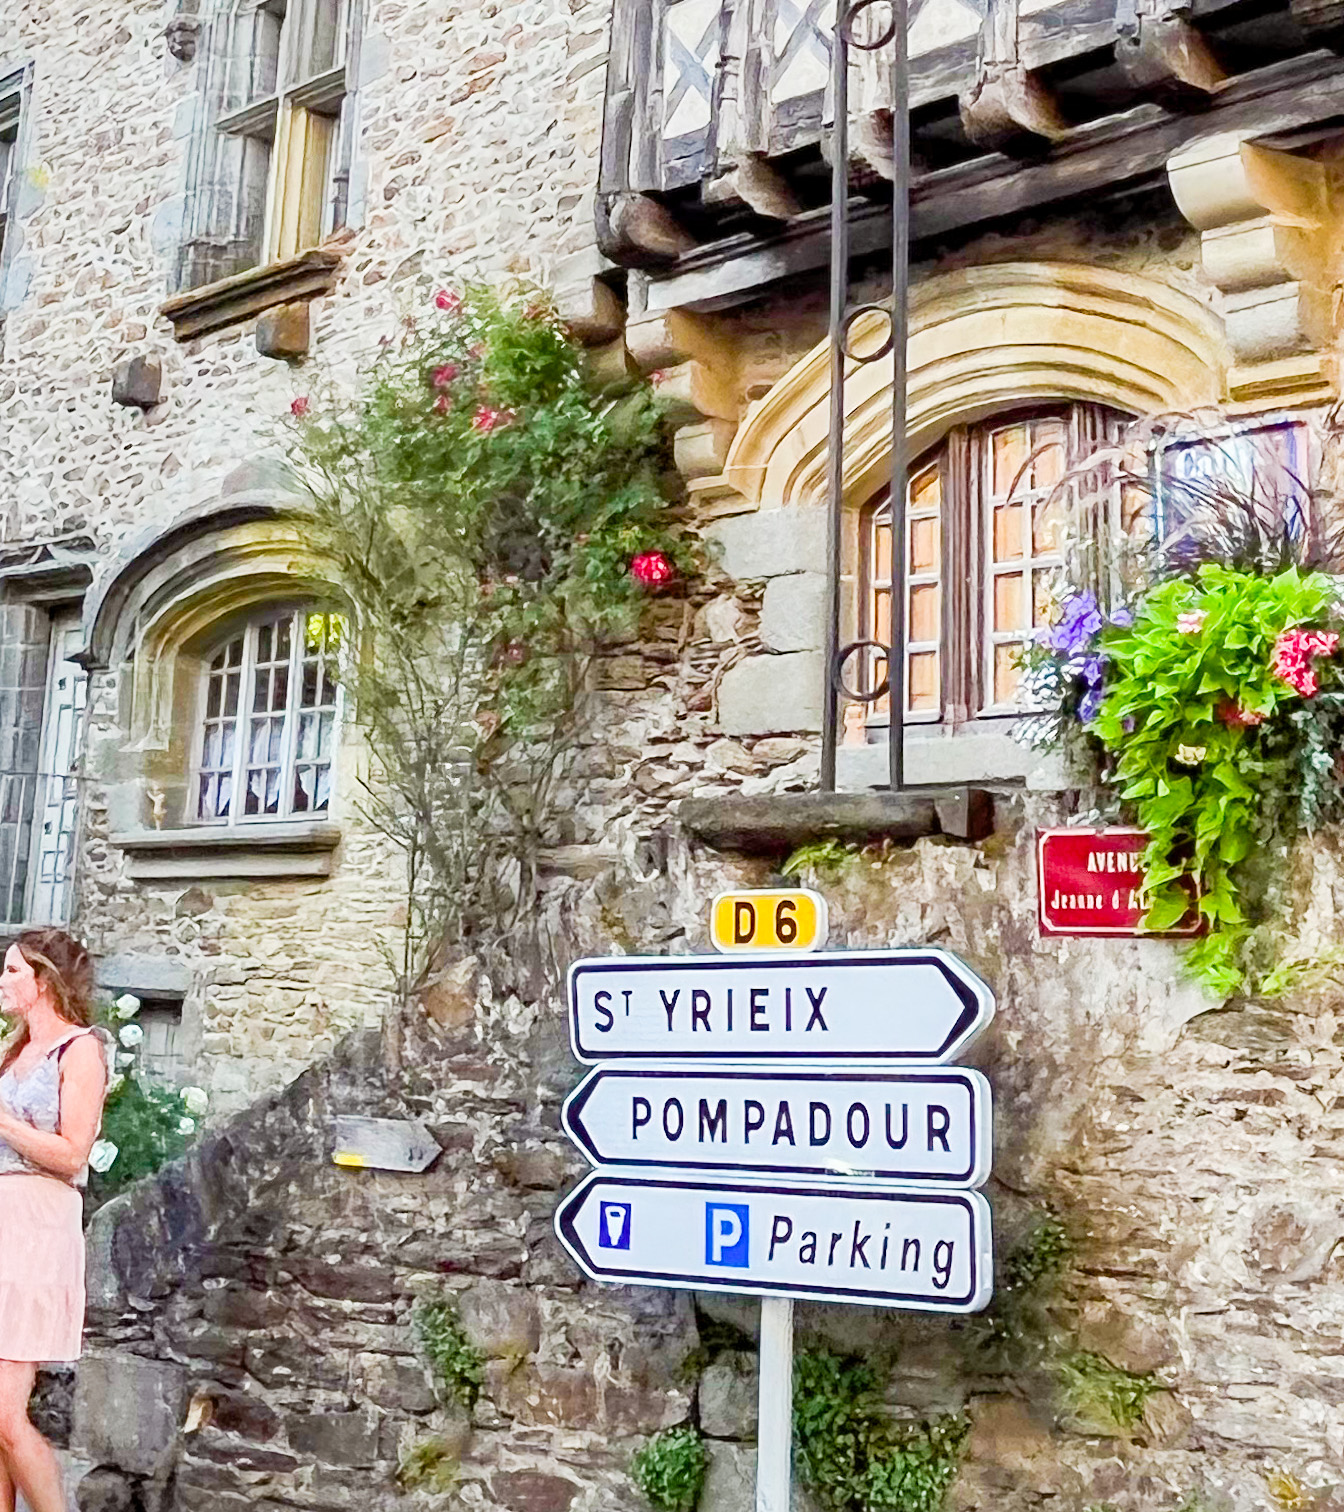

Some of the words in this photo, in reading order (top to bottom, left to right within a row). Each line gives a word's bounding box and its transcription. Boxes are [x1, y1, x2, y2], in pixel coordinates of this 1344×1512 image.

[1087, 851, 1148, 873] AVENU
[1051, 889, 1103, 910] Jeanne
[734, 901, 756, 945] D
[775, 900, 798, 944] 6
[659, 986, 829, 1032] YRIEIX
[631, 1096, 952, 1153] POMPADOUR
[767, 1215, 955, 1289] Parking
